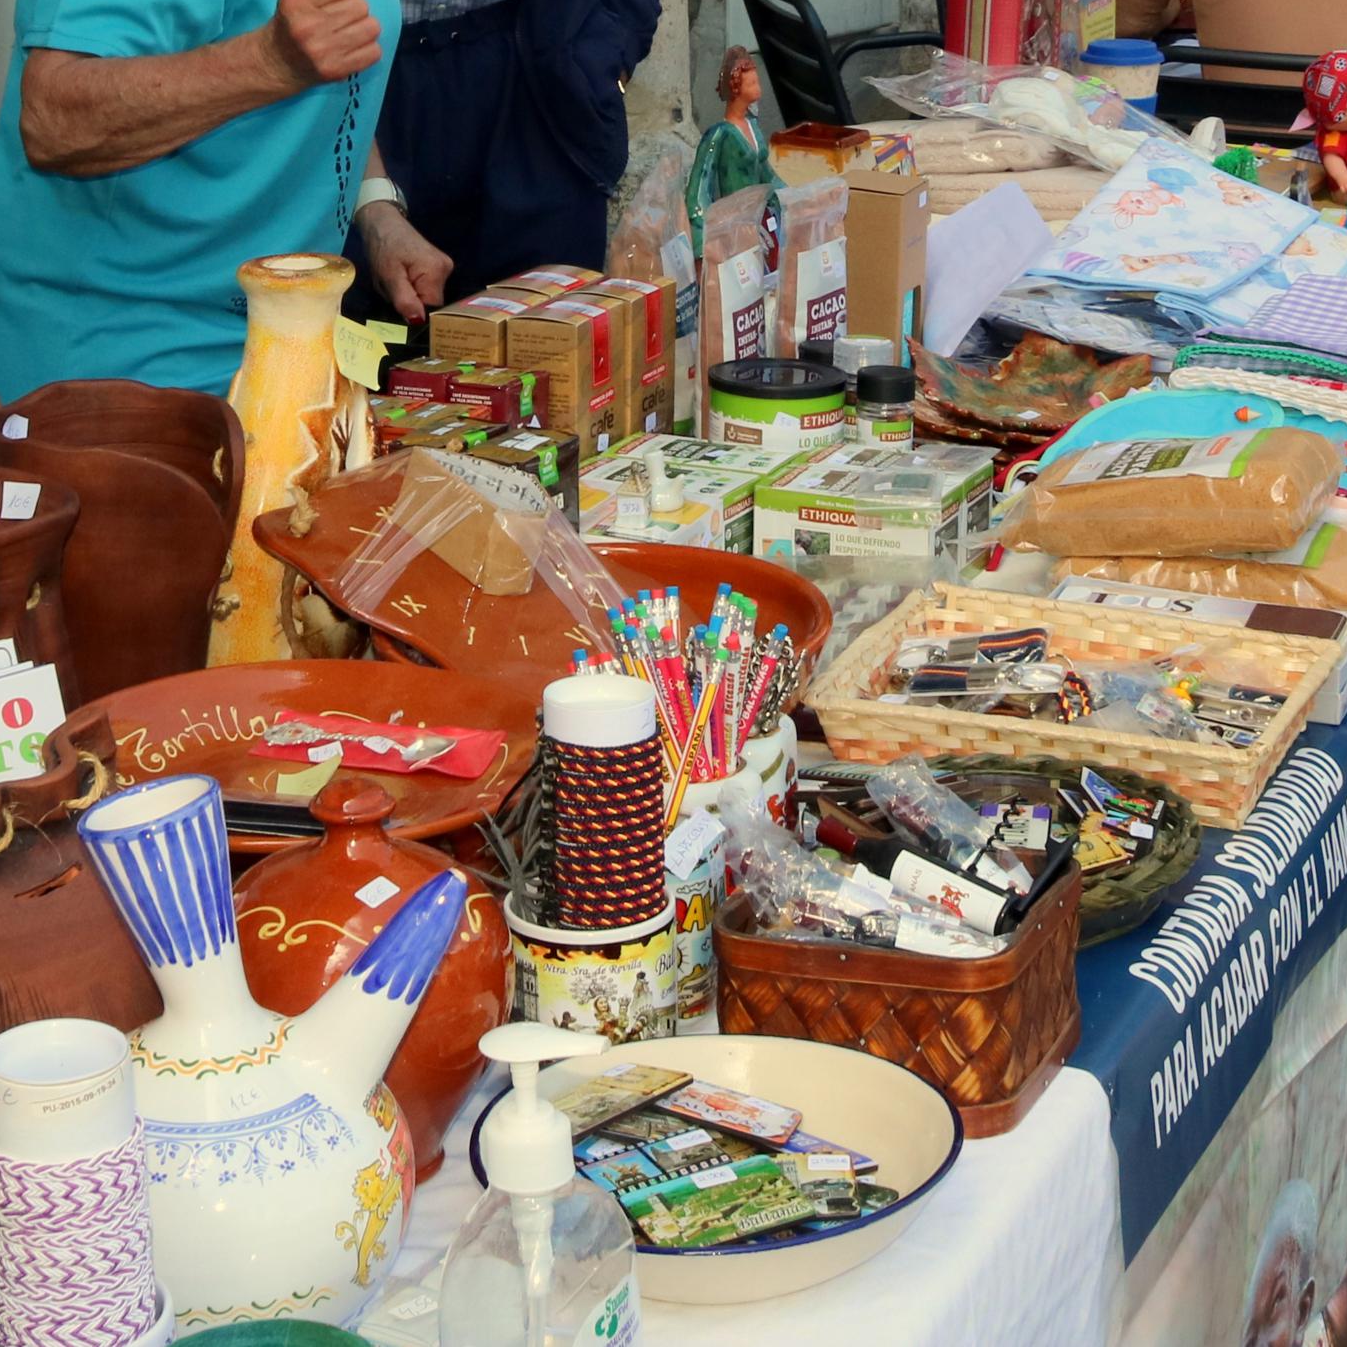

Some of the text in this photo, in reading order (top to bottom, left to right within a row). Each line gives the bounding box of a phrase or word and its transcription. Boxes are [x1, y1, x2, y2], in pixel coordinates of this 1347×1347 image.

[736, 304, 764, 332] CACAO
[811, 293, 846, 319] CACAO
[642, 382, 665, 411] café
[590, 408, 614, 437] café
[799, 436, 831, 448] LO QUE
[835, 534, 844, 542] LO
[863, 536, 901, 549] DEFIENDO
[1129, 748, 1345, 1014] CONTAGIA SOLIDARIDAD
[543, 963, 569, 974] Ntra.
[609, 959, 642, 975] Revilla
[1150, 1023, 1198, 1149] PARA
[1200, 931, 1269, 1076] ACABAR
[1268, 893, 1303, 977] CON
[1305, 863, 1324, 919] EL
